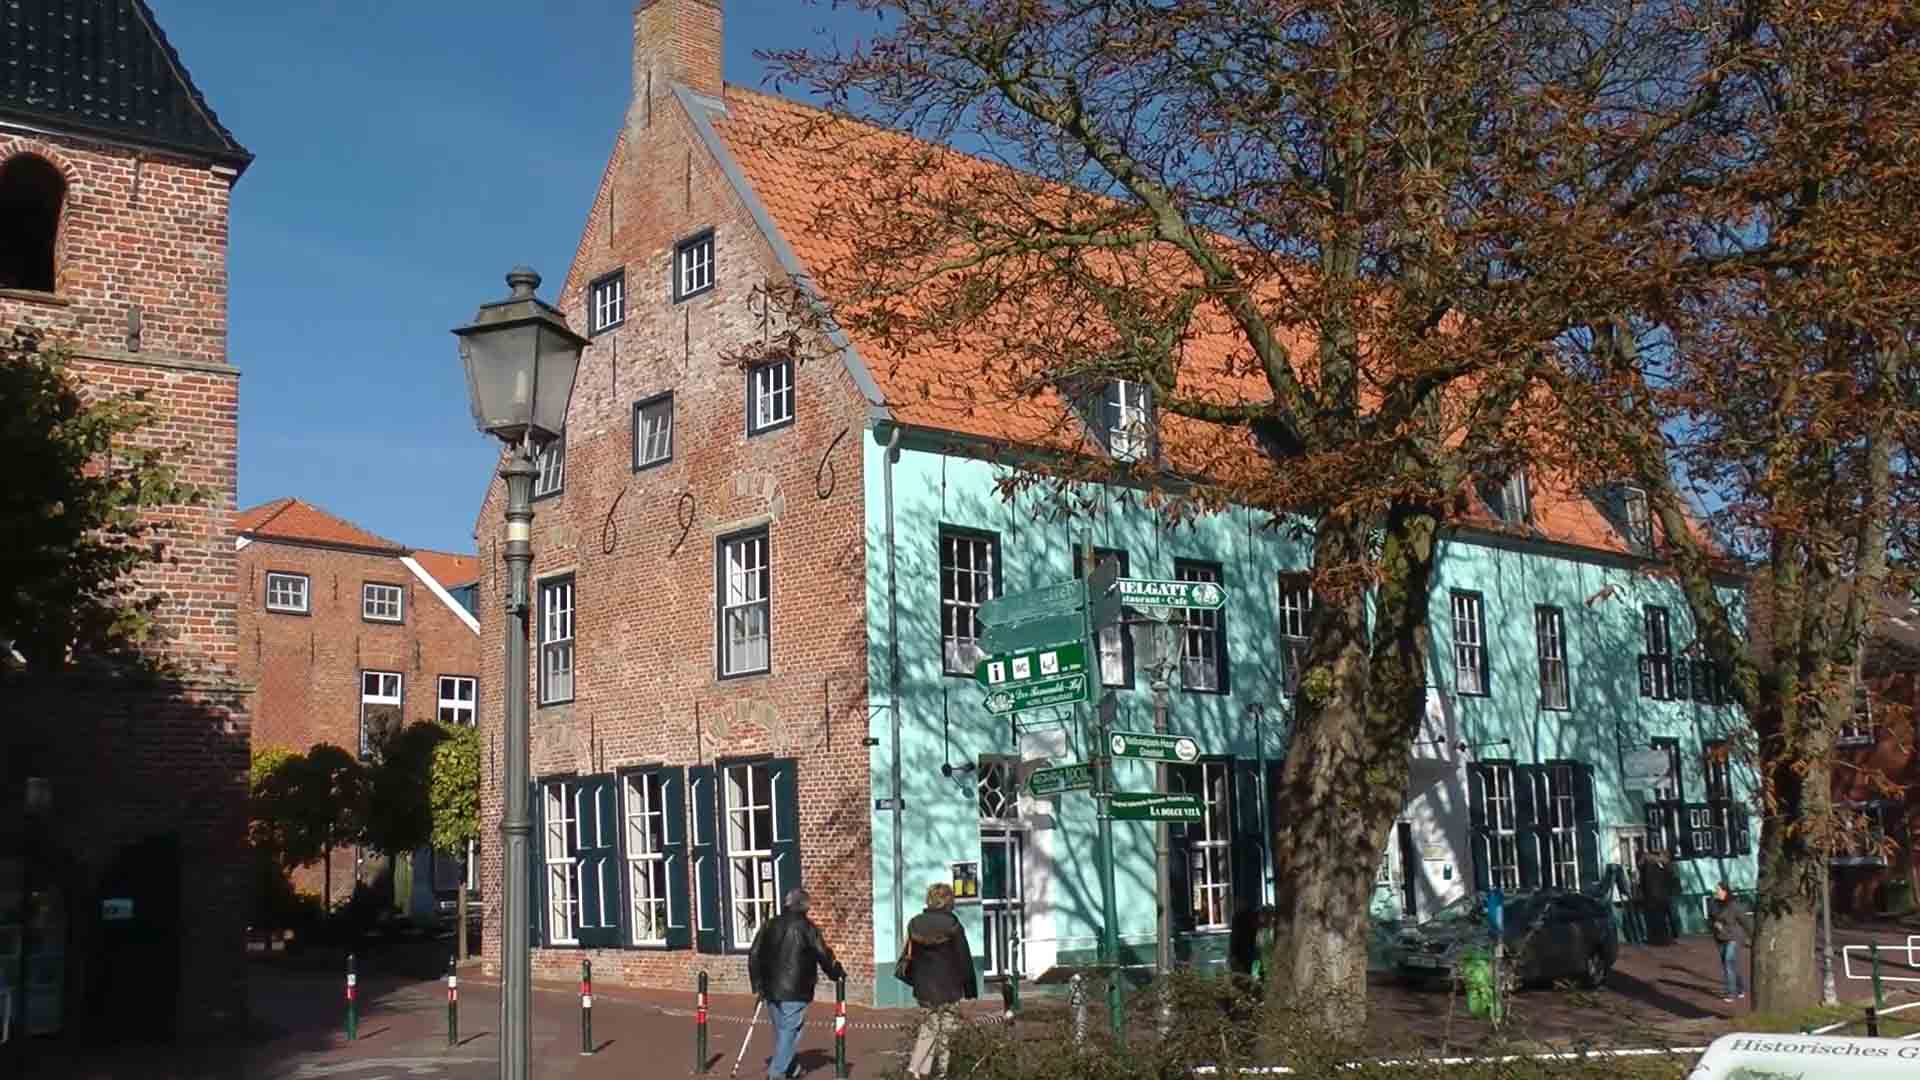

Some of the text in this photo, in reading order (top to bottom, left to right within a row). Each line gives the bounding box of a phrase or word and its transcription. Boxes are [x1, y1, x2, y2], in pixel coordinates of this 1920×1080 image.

[1120, 582, 1188, 596] IELGATT
[1122, 594, 1160, 603] staurant
[1730, 1039, 1889, 1057] Historisches
